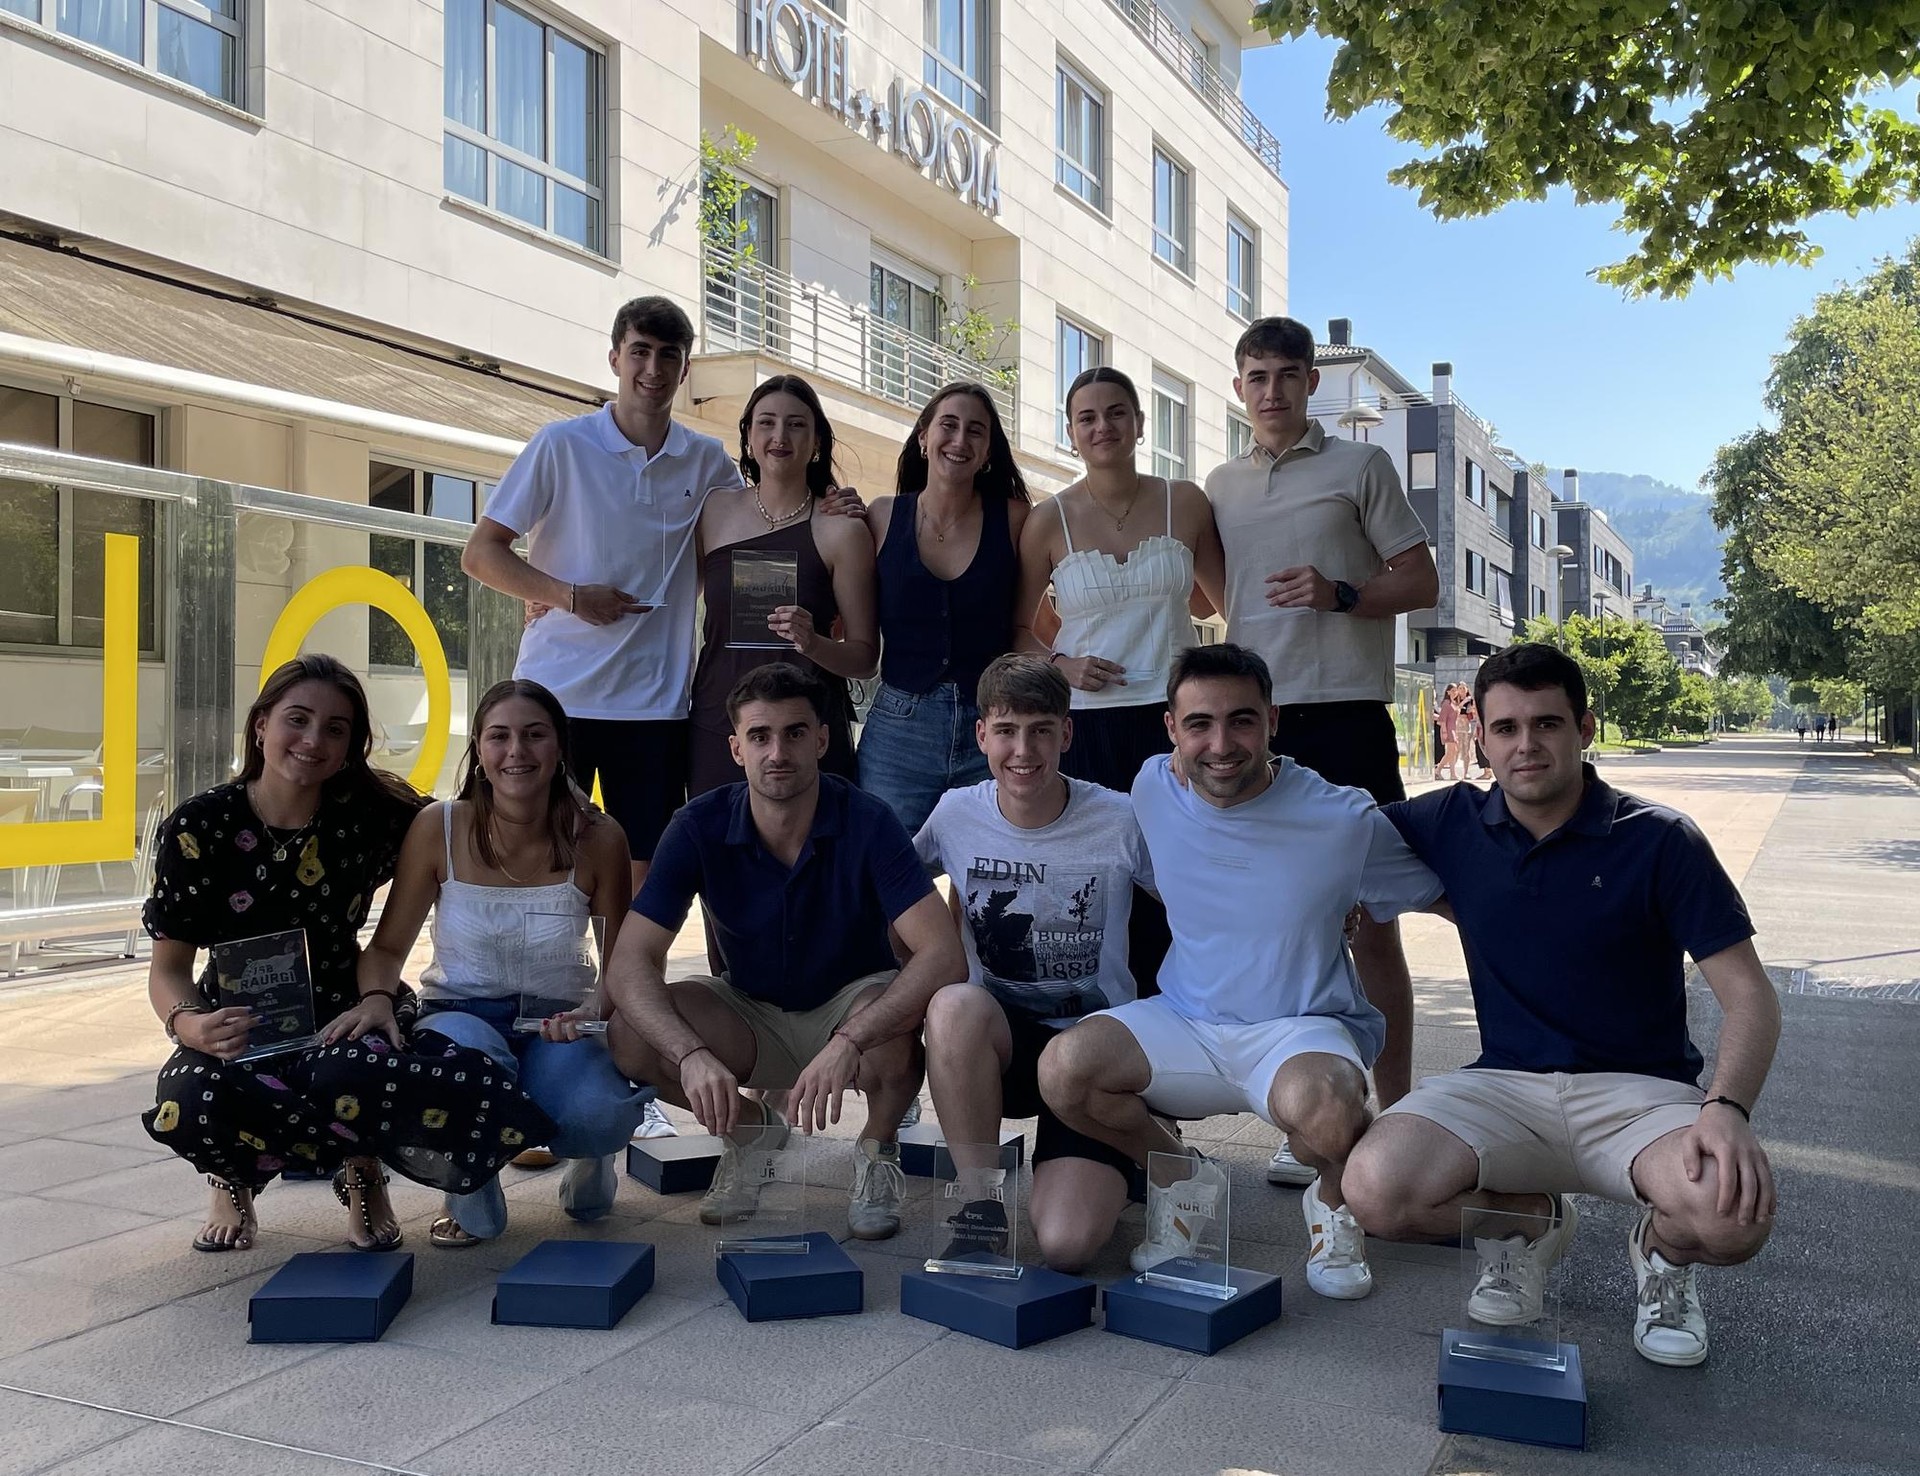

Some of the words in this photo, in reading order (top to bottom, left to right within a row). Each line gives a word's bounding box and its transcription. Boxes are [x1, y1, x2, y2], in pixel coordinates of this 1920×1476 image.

[750, 0, 855, 119] HOTEL
[972, 857, 1047, 883] EDIN
[1038, 929, 1105, 943] BURGH
[1039, 958, 1098, 980] 1889
